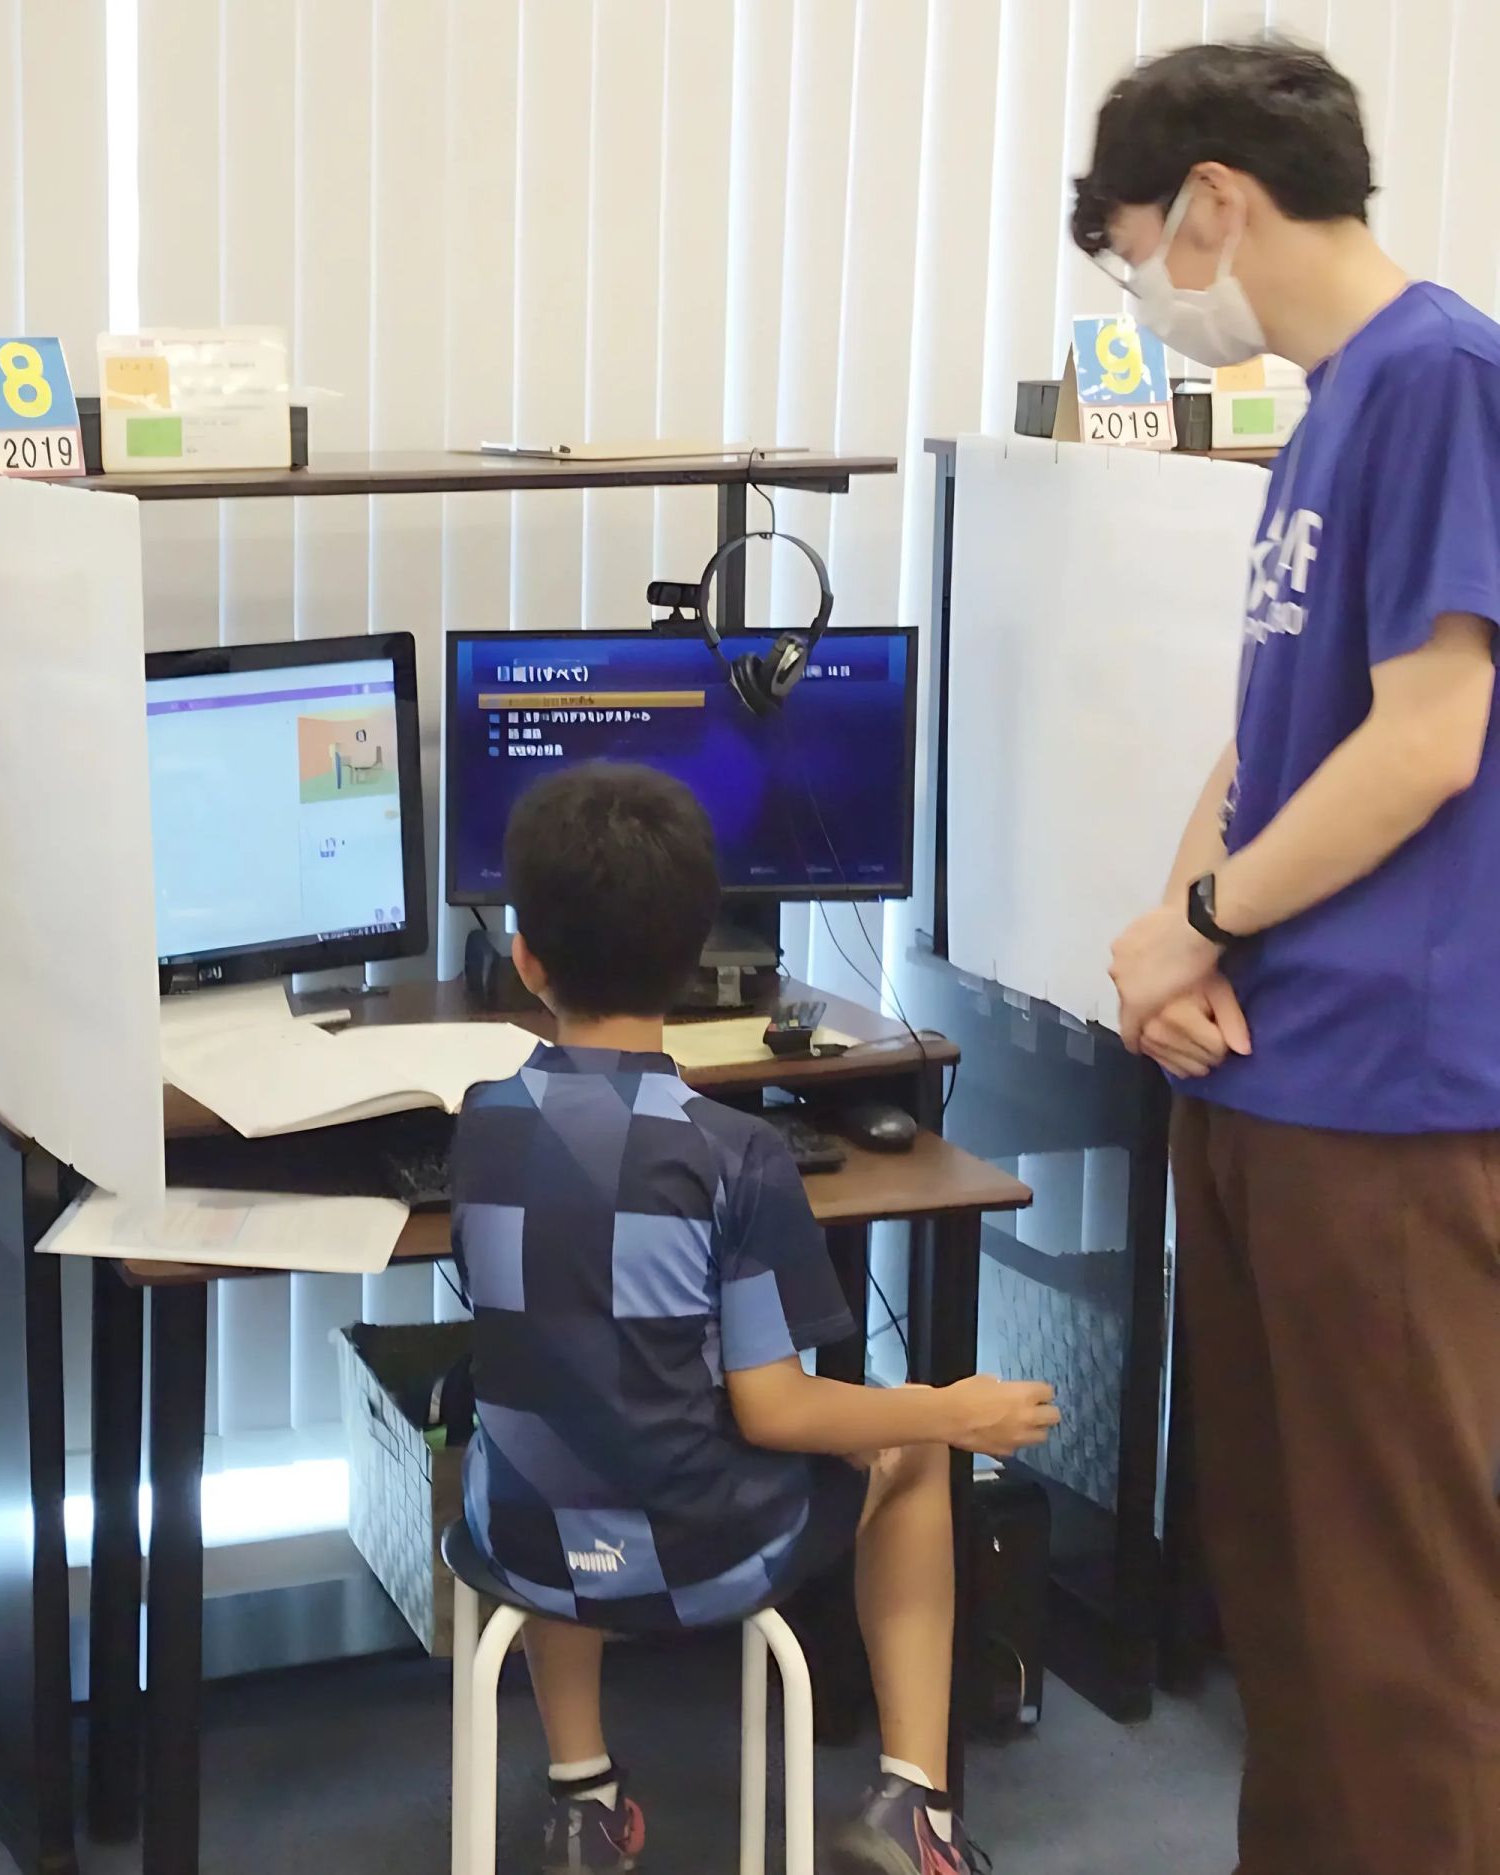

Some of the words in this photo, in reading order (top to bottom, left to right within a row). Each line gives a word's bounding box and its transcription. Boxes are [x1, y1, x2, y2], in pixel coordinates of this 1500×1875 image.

[1095, 323, 1144, 394] 9
[1090, 411, 1159, 439] 2019
[4, 437, 73, 468] 2019
